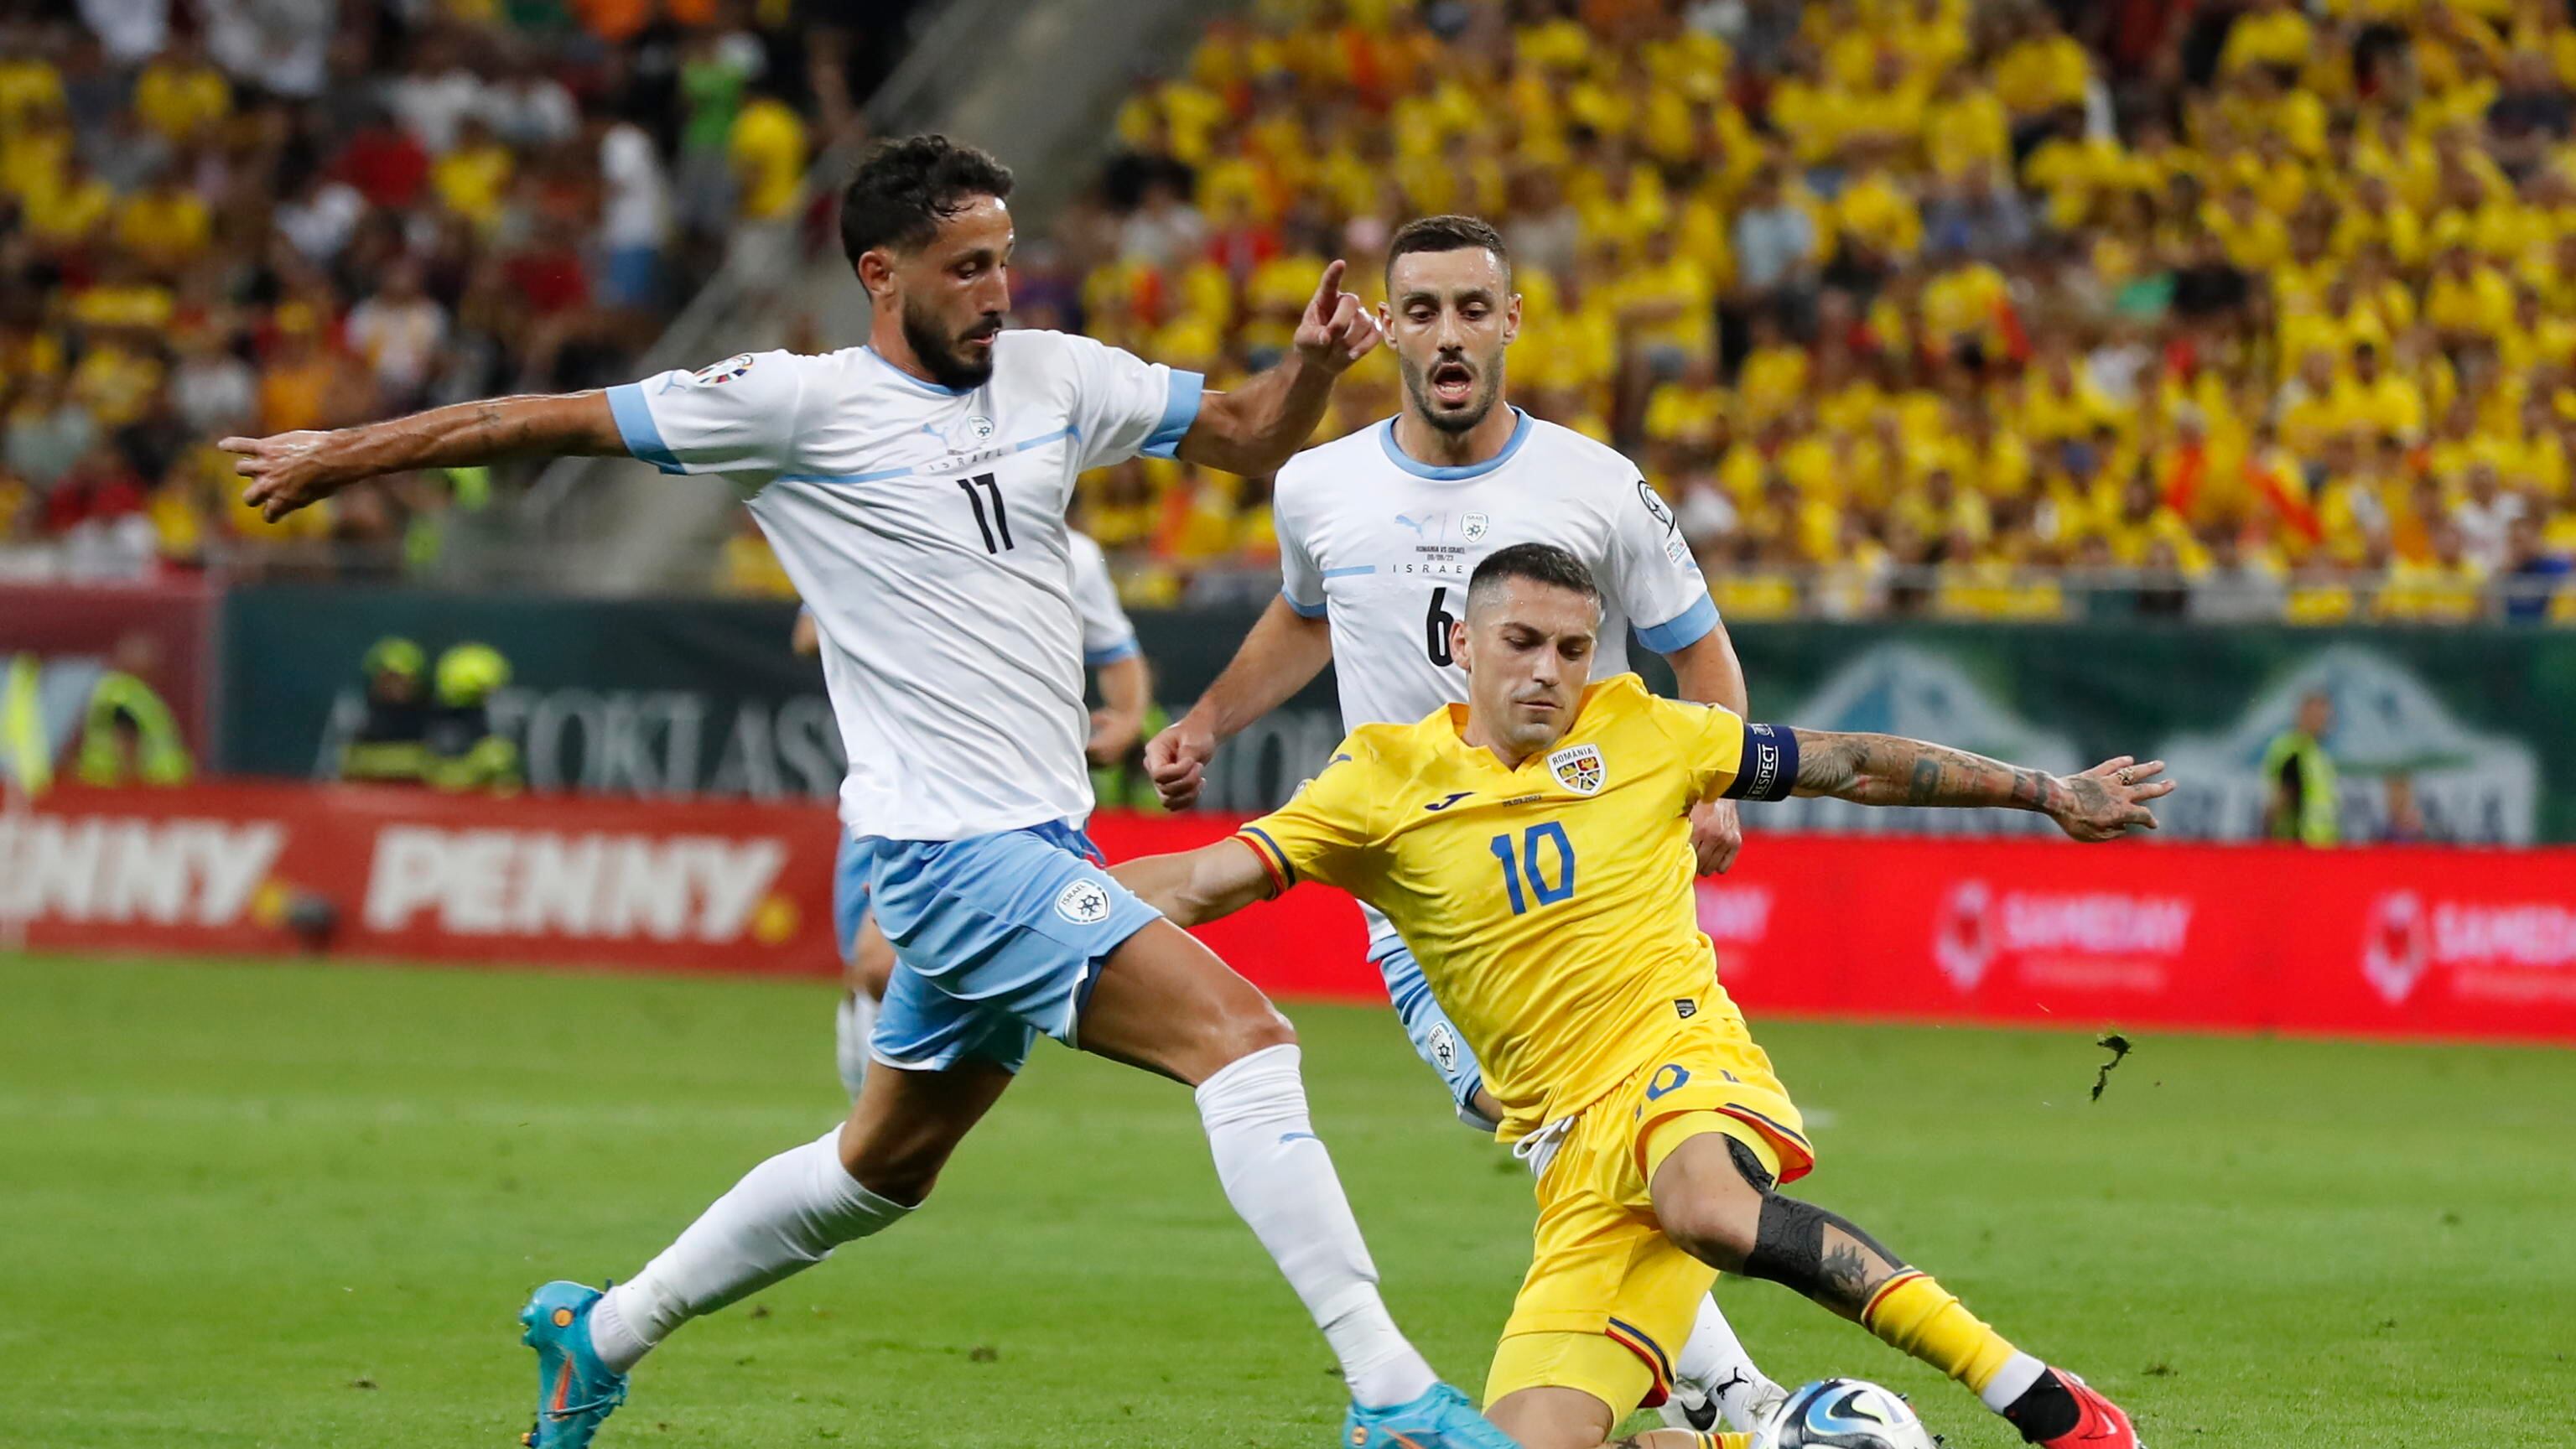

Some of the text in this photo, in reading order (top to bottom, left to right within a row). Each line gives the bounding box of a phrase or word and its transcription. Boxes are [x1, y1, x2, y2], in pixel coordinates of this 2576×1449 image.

[956, 472, 1015, 554] 17
[1393, 564, 1476, 574] ISRAE
[1426, 587, 1455, 667] 6
[1751, 743, 1775, 796] RESPECT
[364, 822, 788, 944] PENNY
[1490, 820, 1575, 916] 10
